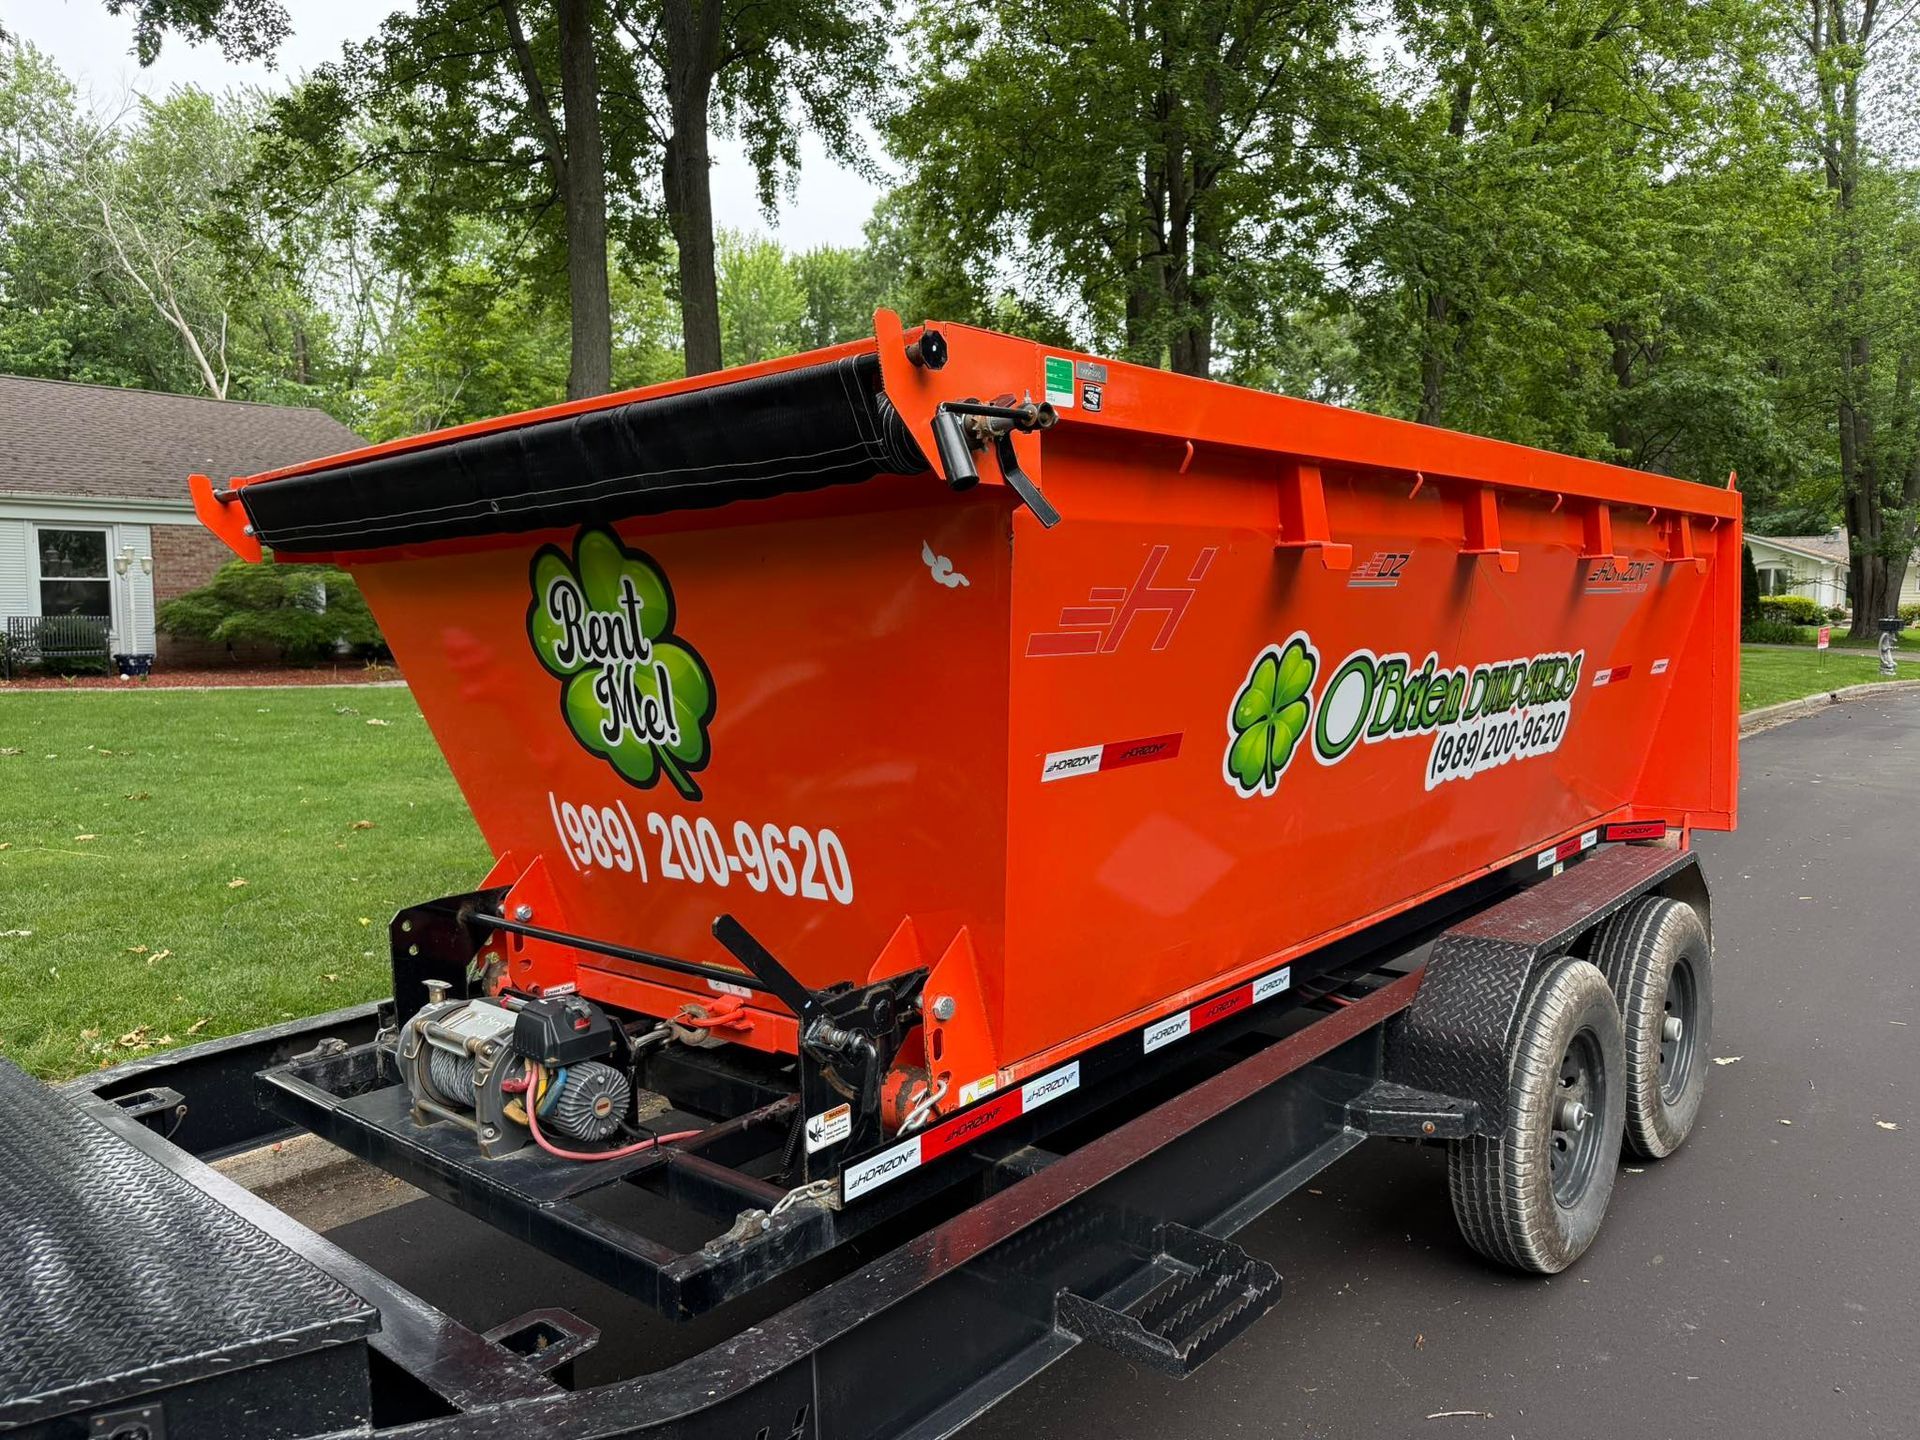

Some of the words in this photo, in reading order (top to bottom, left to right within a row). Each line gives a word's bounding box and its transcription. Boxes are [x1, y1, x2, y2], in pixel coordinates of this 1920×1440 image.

[548, 578, 651, 665] Rent
[595, 663, 678, 743] Me!
[1315, 654, 1465, 760] O'Brien
[1051, 754, 1093, 773] HORIZON
[548, 791, 648, 883] (989)
[646, 811, 854, 905] 200-9620
[1258, 976, 1286, 995] HORIZON
[1150, 1019, 1184, 1045] HORIZON
[1030, 1072, 1072, 1102] HORIZON
[948, 1108, 998, 1142] HORIZON
[855, 1150, 911, 1190] HORIZON
